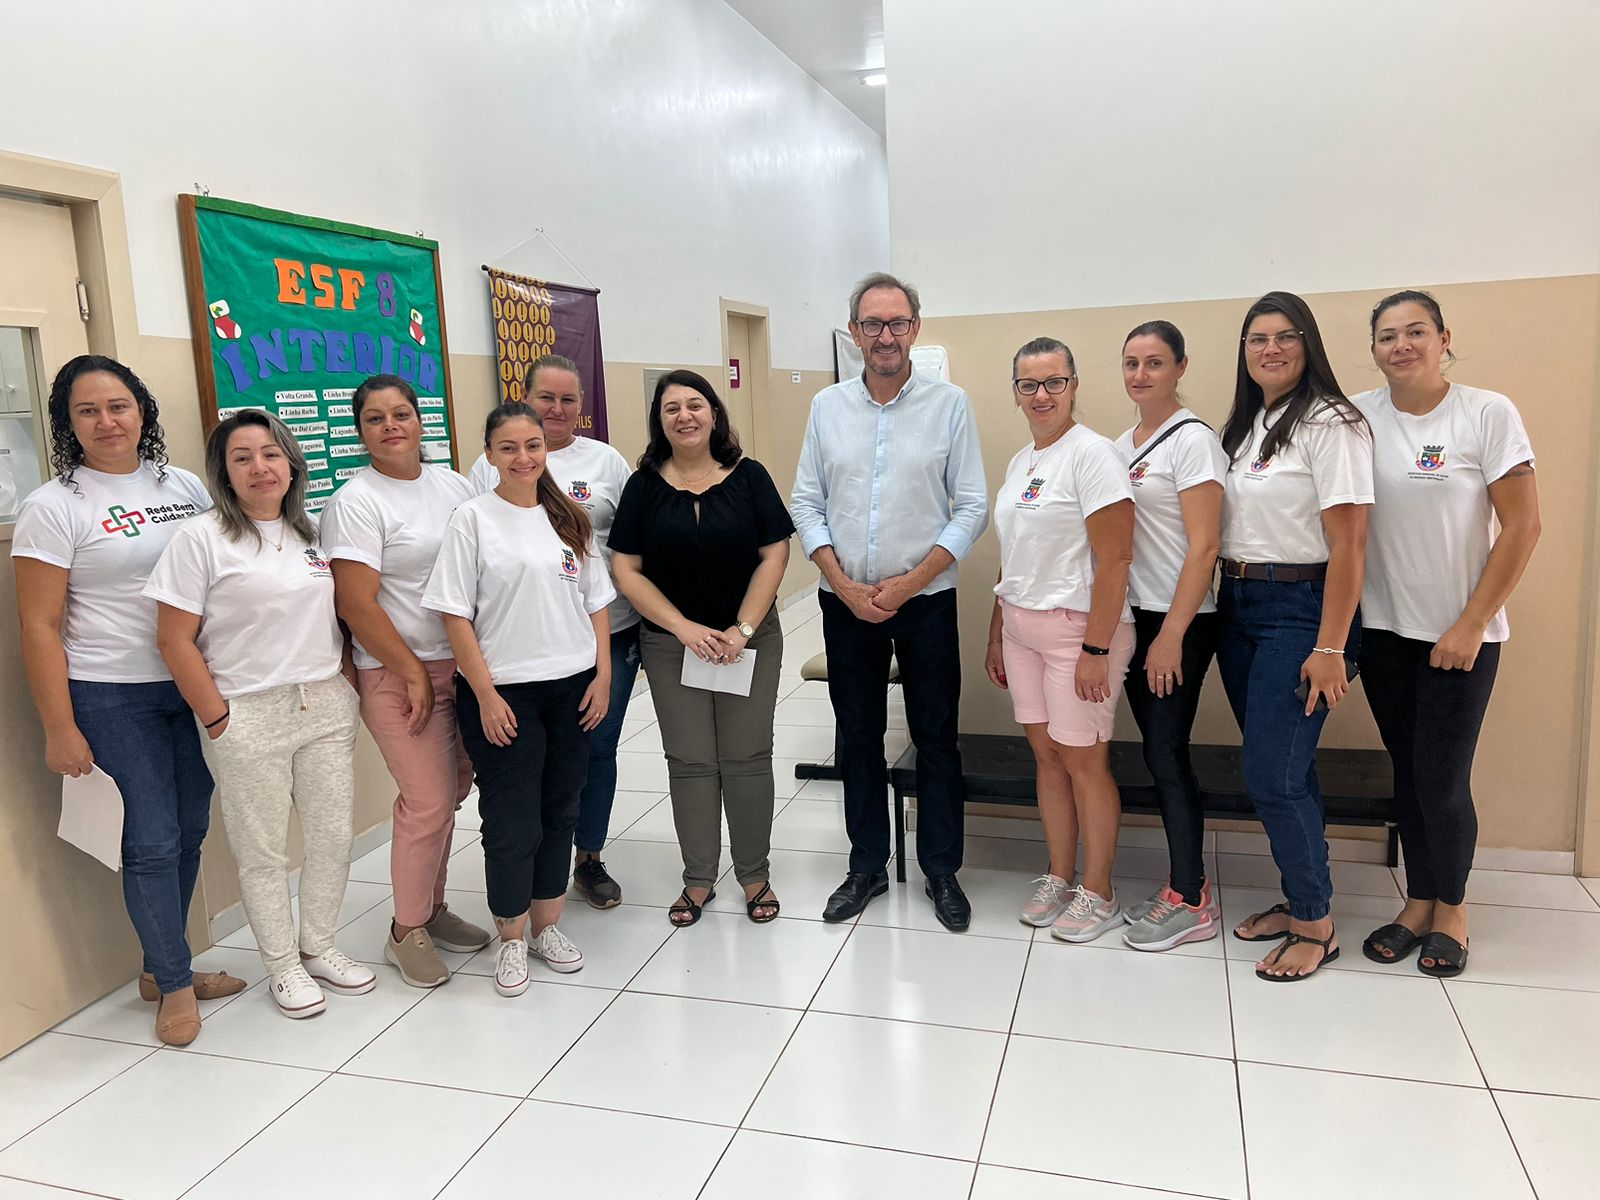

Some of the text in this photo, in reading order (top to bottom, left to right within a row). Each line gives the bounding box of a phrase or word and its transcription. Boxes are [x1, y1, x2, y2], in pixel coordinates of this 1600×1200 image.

[274, 258, 396, 317] ESF 8
[221, 328, 438, 394] INTERIOR
[145, 503, 195, 515] Rede Bem
[151, 513, 186, 524] Cuidar
